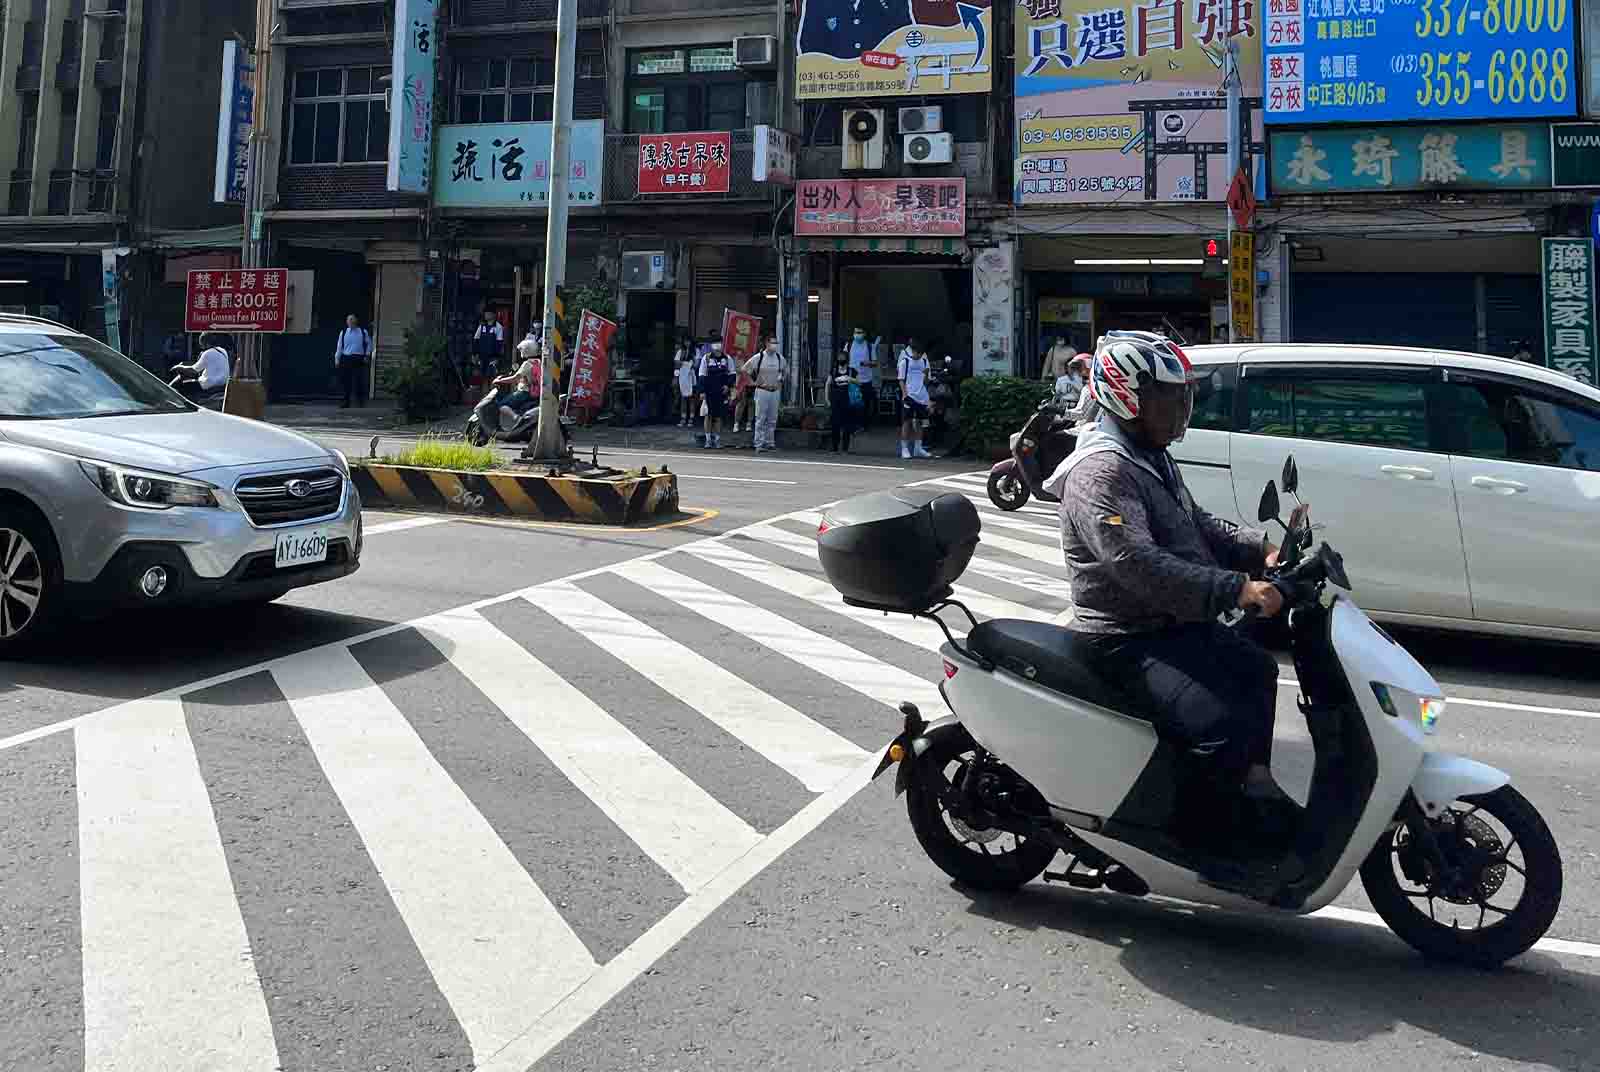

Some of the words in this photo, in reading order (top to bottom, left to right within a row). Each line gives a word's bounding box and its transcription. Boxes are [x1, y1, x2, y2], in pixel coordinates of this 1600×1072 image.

[1270, 20, 1300, 44] 分校
[818, 70, 860, 81] 461-5566
[1391, 54, 1418, 73] (03)
[1416, 48, 1568, 106] 355-6888
[1270, 86, 1301, 110] 分校
[1022, 126, 1132, 144] 03-4633535
[641, 141, 727, 170] 傳承古早味
[195, 271, 280, 289] 禁止跨越
[277, 535, 327, 561] AYJ-6609
